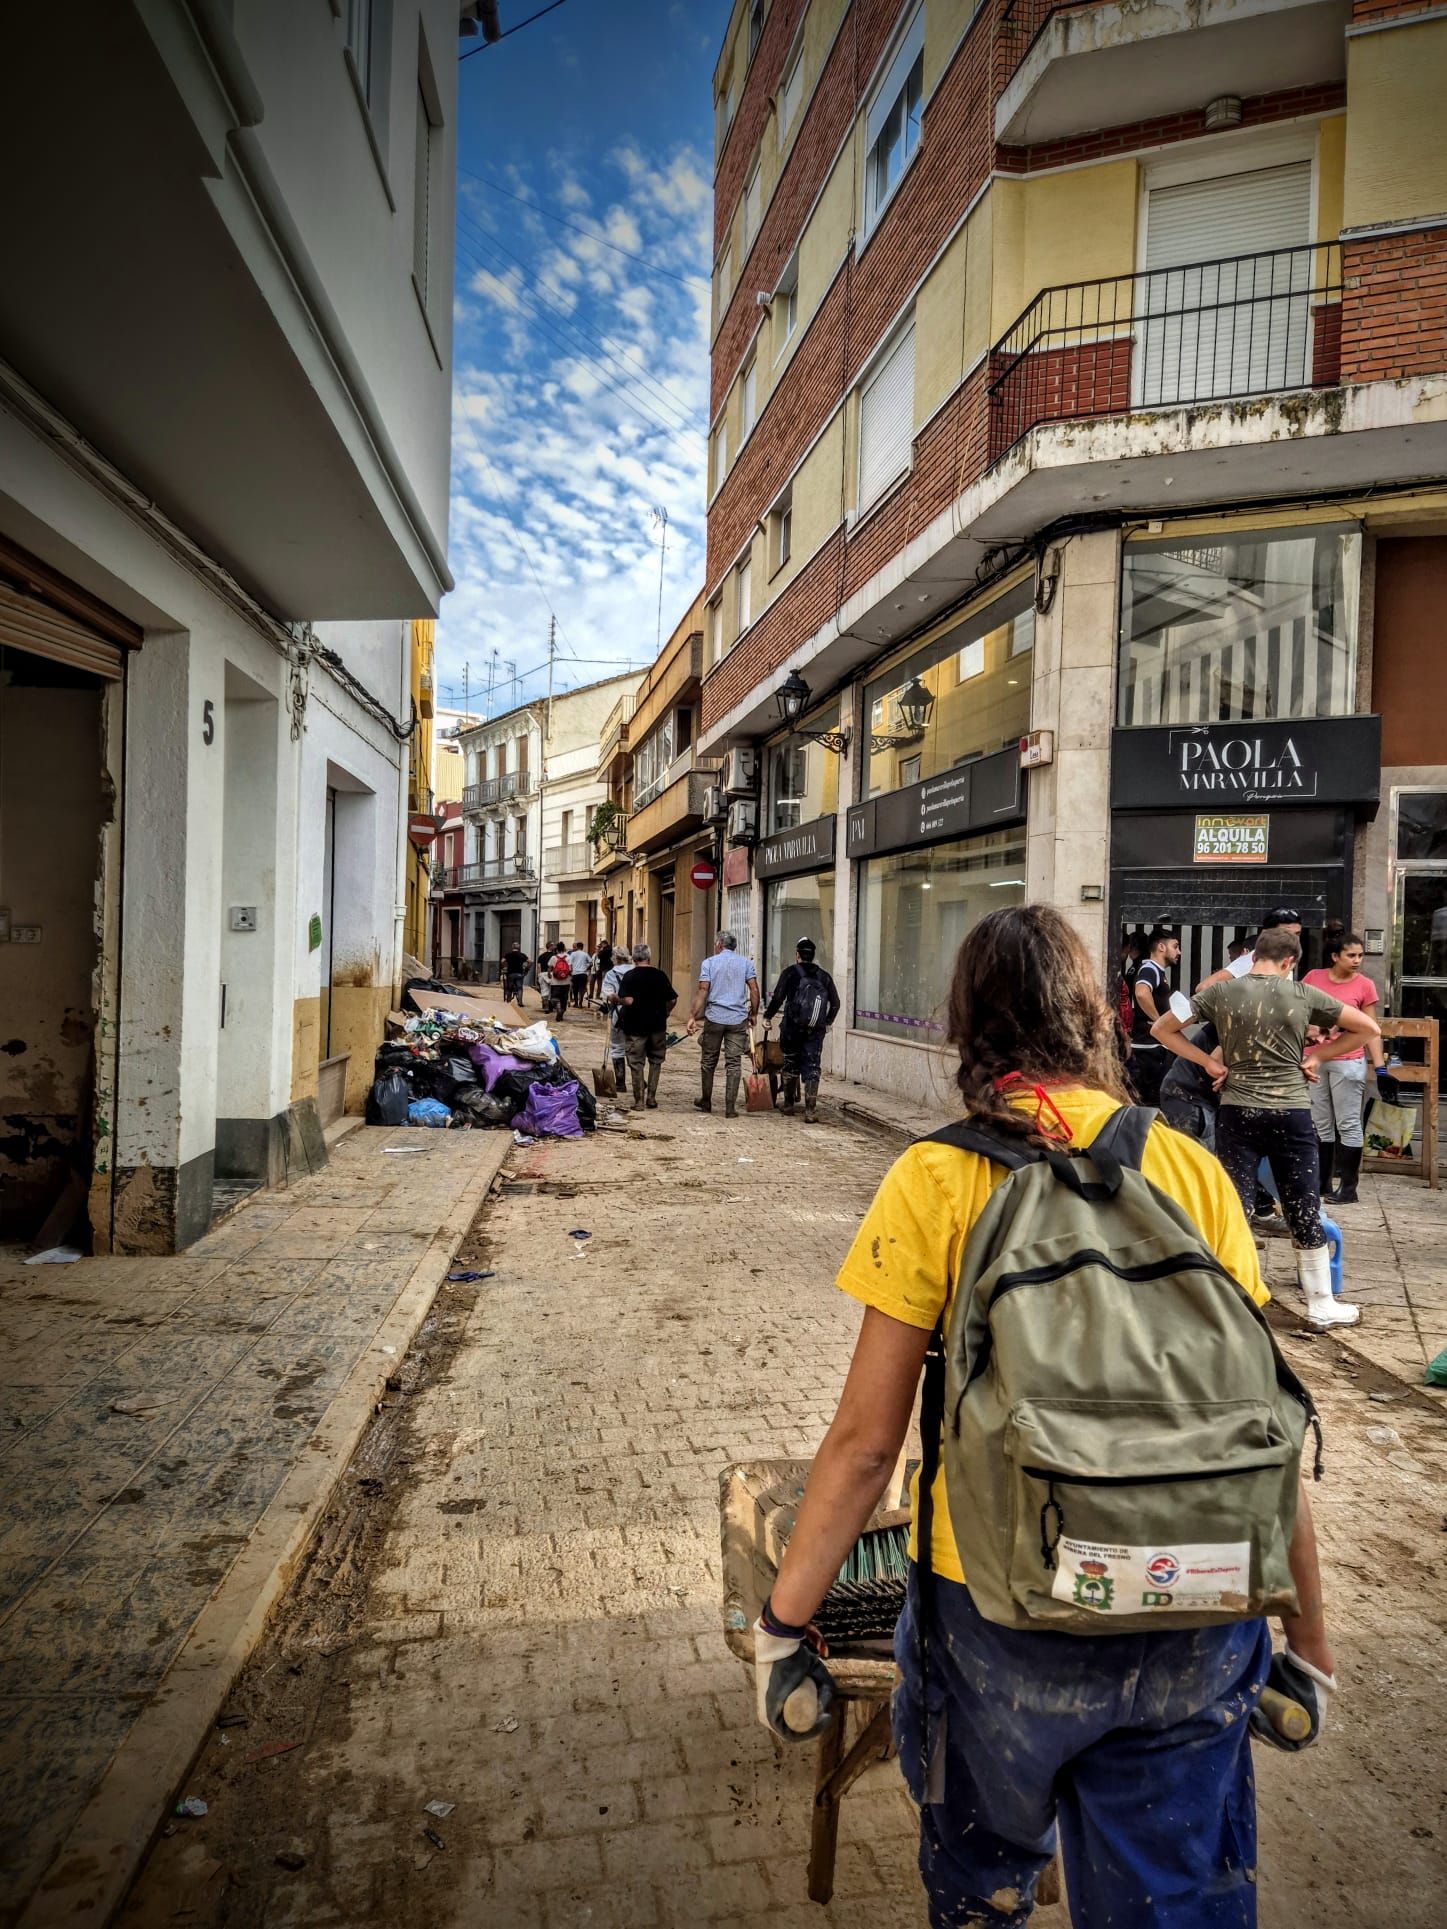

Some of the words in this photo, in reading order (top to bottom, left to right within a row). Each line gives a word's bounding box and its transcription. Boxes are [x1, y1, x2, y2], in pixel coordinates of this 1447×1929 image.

[202, 698, 214, 746] 5
[1176, 737, 1304, 771] PAOLA
[1179, 770, 1304, 790] MARAVILLA
[1197, 828, 1265, 842] ALQUILA
[1197, 842, 1210, 854] 96
[1213, 842, 1232, 854] 201
[1235, 842, 1249, 854] 78
[1251, 842, 1265, 854] 50
[1065, 1540, 1118, 1553] AYUNTAMIENTO
[1103, 1553, 1132, 1561] FRESNO
